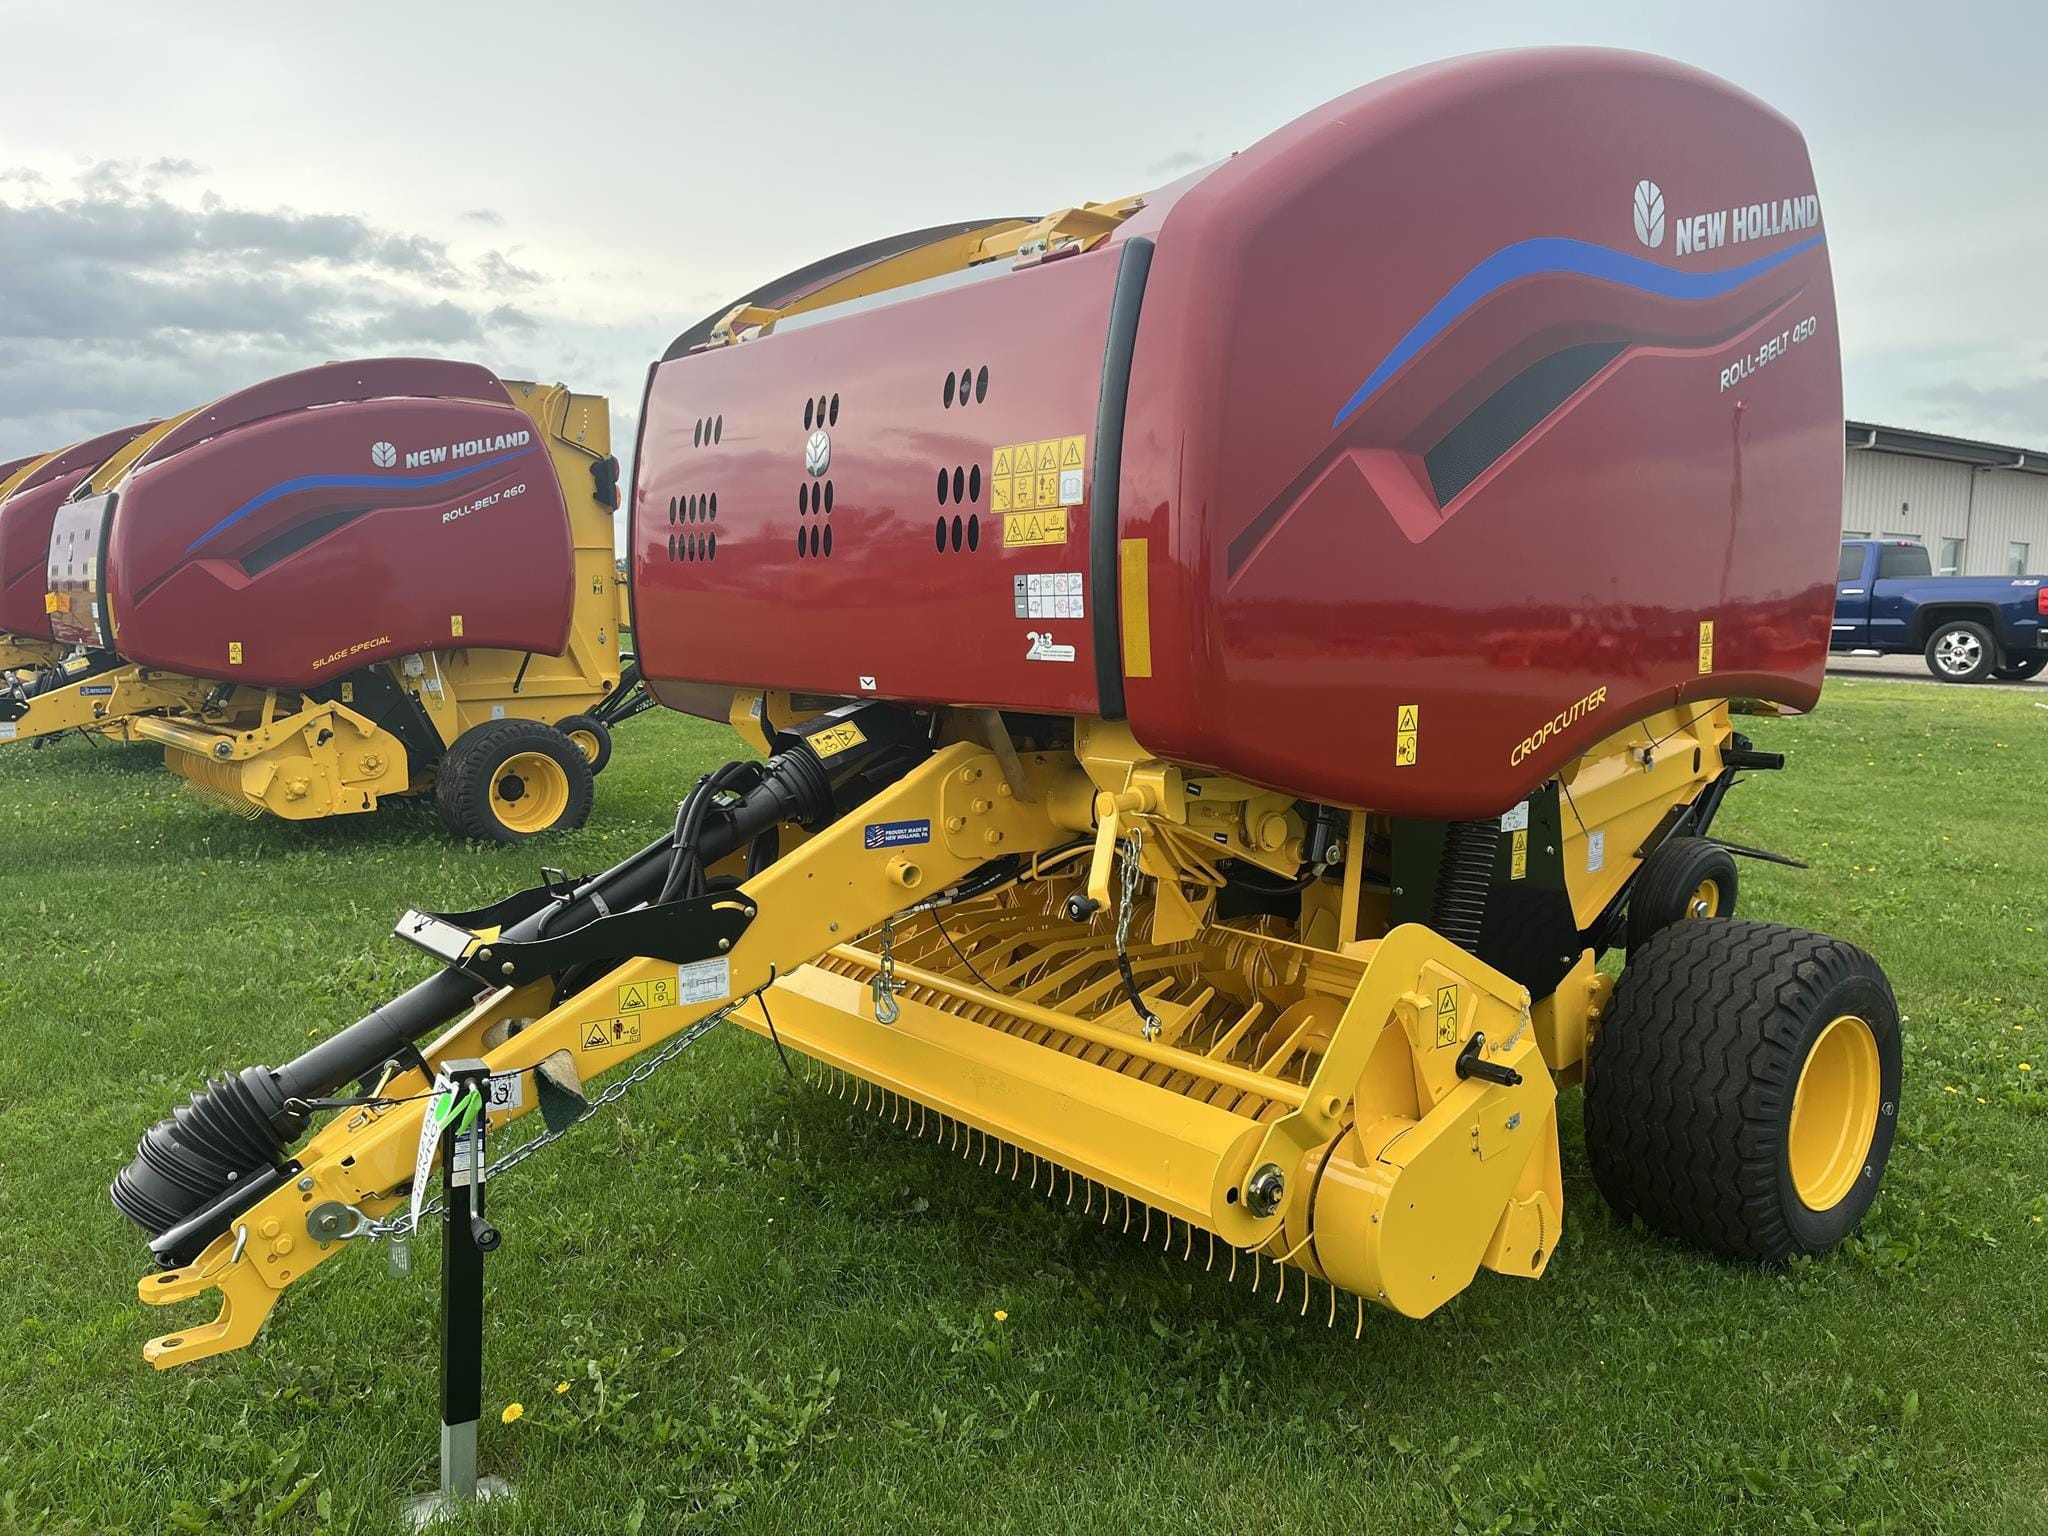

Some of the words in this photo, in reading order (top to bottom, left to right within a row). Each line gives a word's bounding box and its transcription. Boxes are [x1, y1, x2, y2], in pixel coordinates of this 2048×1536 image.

[1676, 210, 1728, 257] NEW
[1733, 194, 1820, 244] HOLLAND
[1719, 330, 1790, 393] ROLL-BELT
[1792, 315, 1817, 345] 450
[405, 446, 448, 469] NEW
[451, 430, 530, 460] HOLLAND
[442, 493, 501, 524] ROLL-BELT
[503, 483, 527, 499] 460
[312, 648, 349, 670] SILAGE
[350, 635, 392, 655] SPECIAL
[1510, 685, 1607, 767] CROPCUTTER
[885, 828, 907, 836] PROUDLY
[907, 826, 922, 834] MADE
